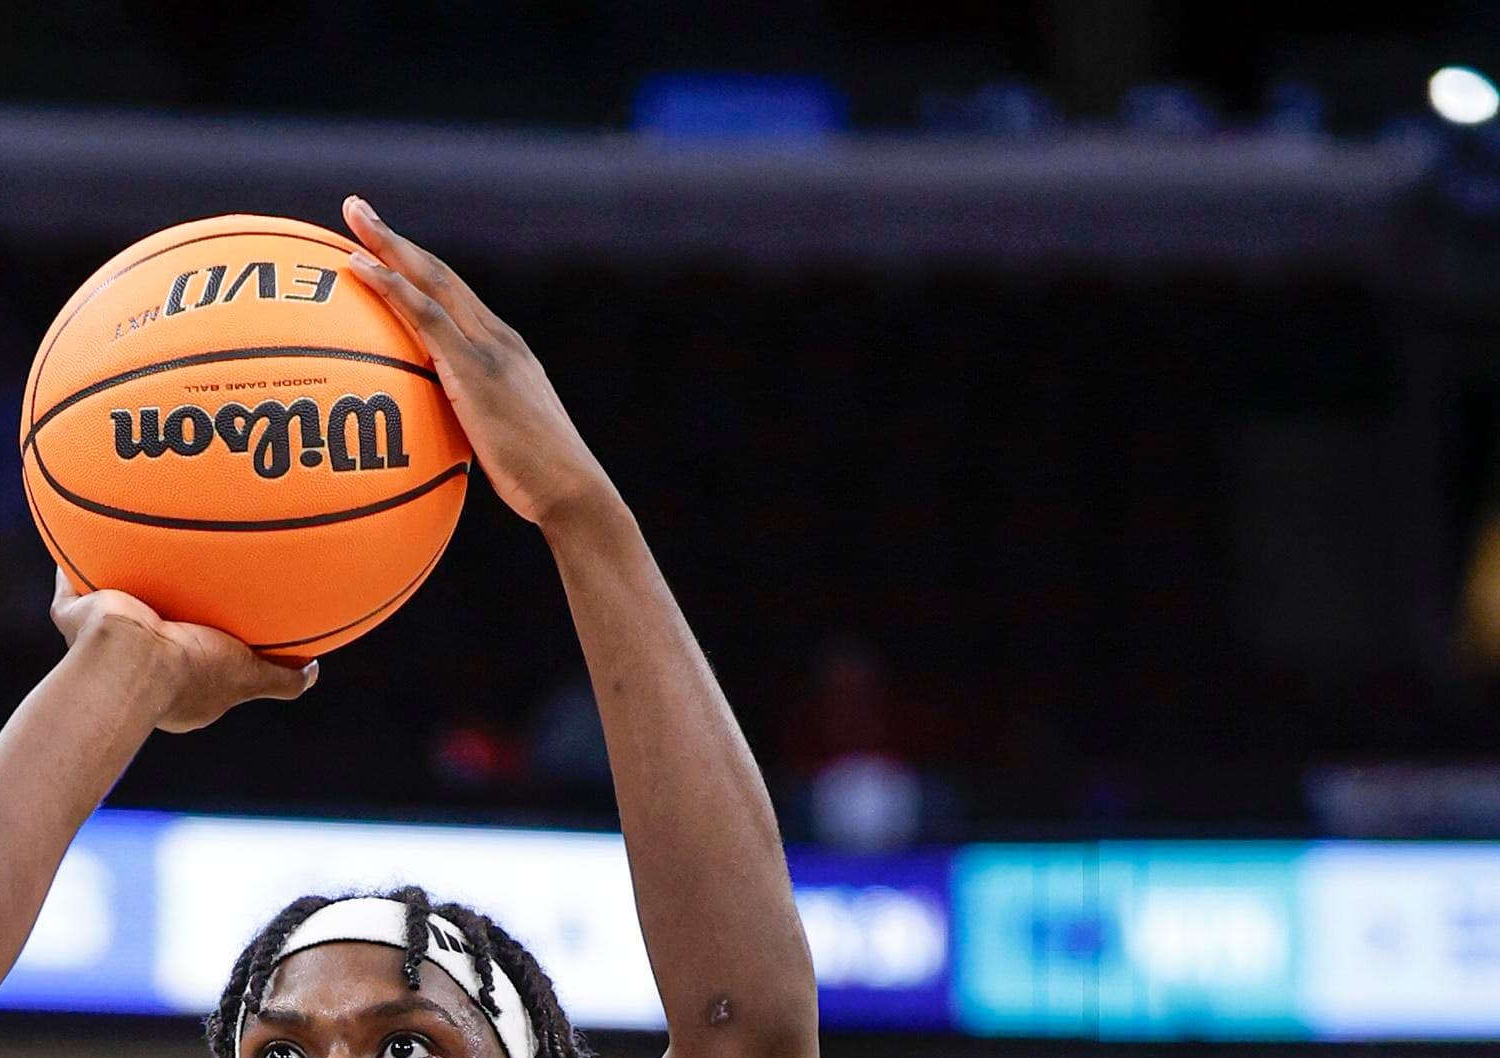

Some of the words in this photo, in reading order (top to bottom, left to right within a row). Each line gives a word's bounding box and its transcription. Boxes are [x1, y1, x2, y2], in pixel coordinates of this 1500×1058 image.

[165, 261, 338, 316] EVO
[225, 380, 267, 391] GAME
[272, 377, 328, 388] INDOOR
[183, 384, 220, 393] BALL
[110, 391, 410, 480] Wilson
